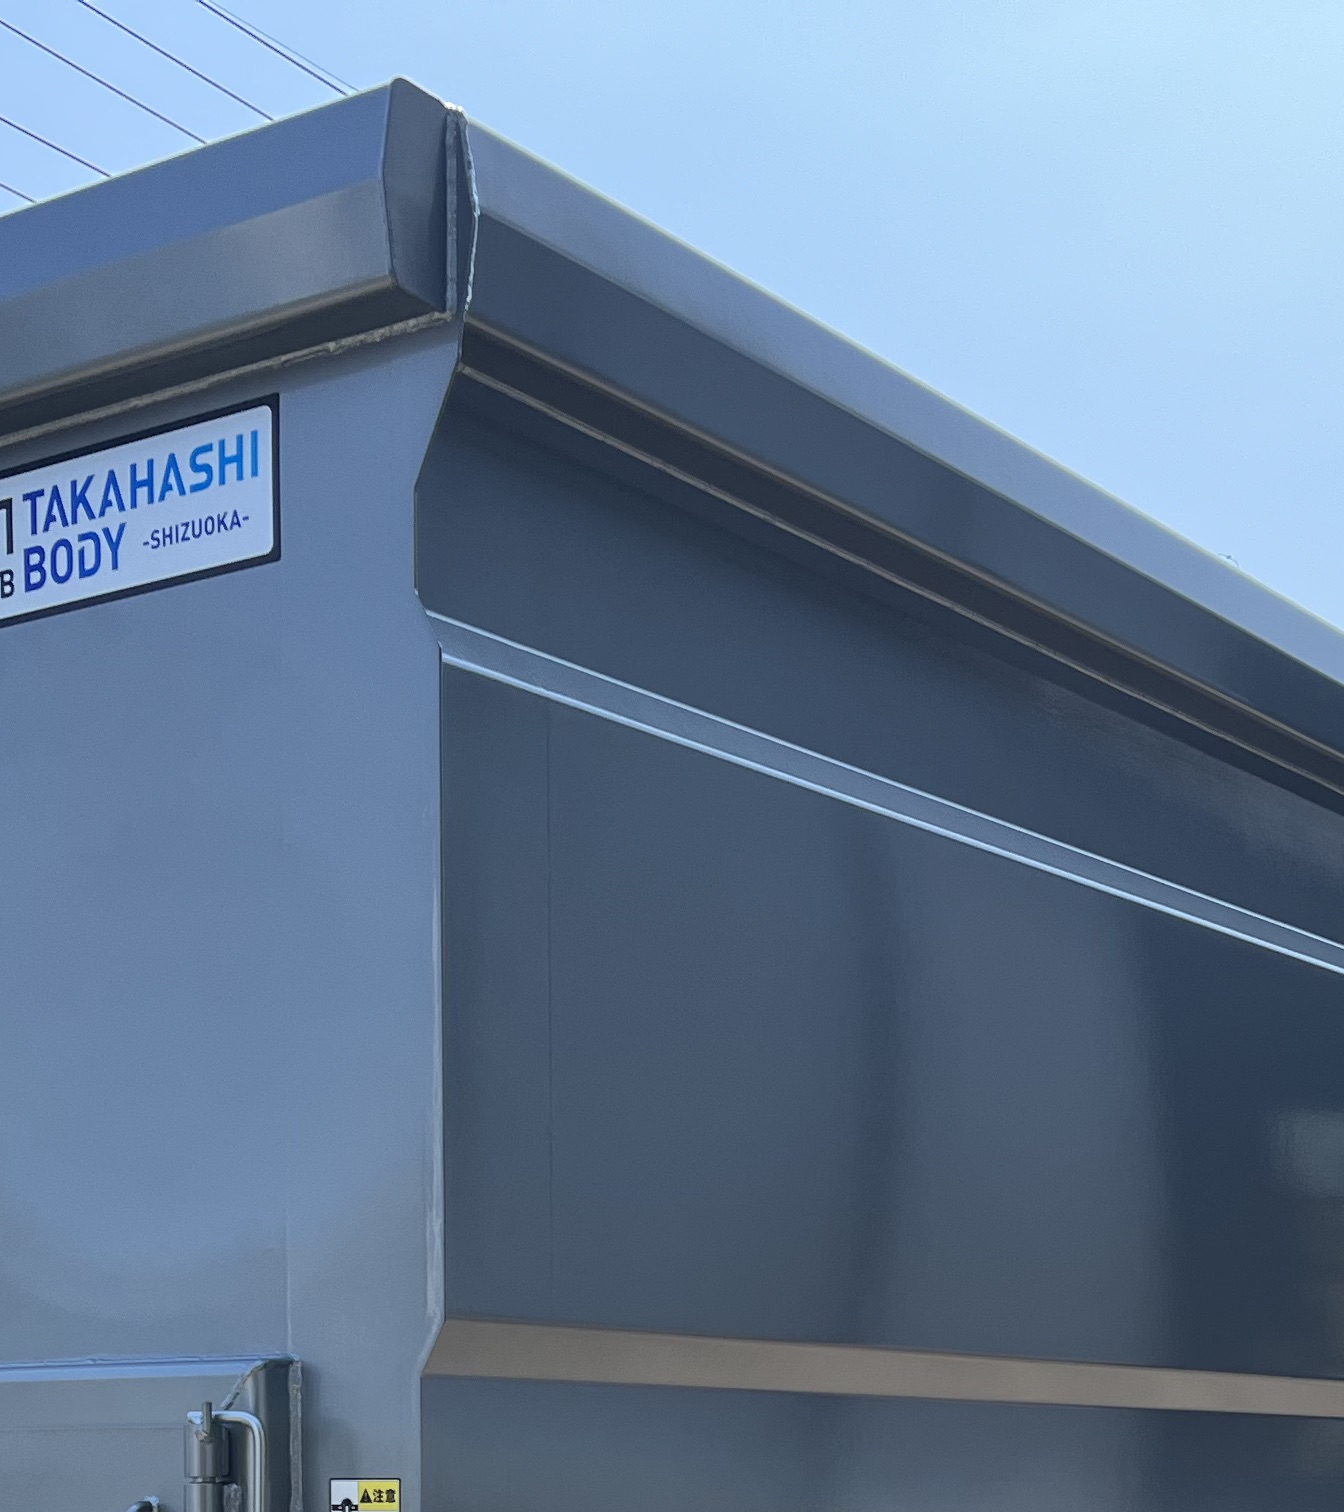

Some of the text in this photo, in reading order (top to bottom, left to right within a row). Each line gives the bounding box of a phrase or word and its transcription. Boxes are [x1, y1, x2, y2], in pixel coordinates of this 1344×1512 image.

[22, 429, 259, 536] TAKAHASHI
[23, 509, 250, 593] BODY -SHIZUOKA-
[372, 1488, 396, 1504] 注意
